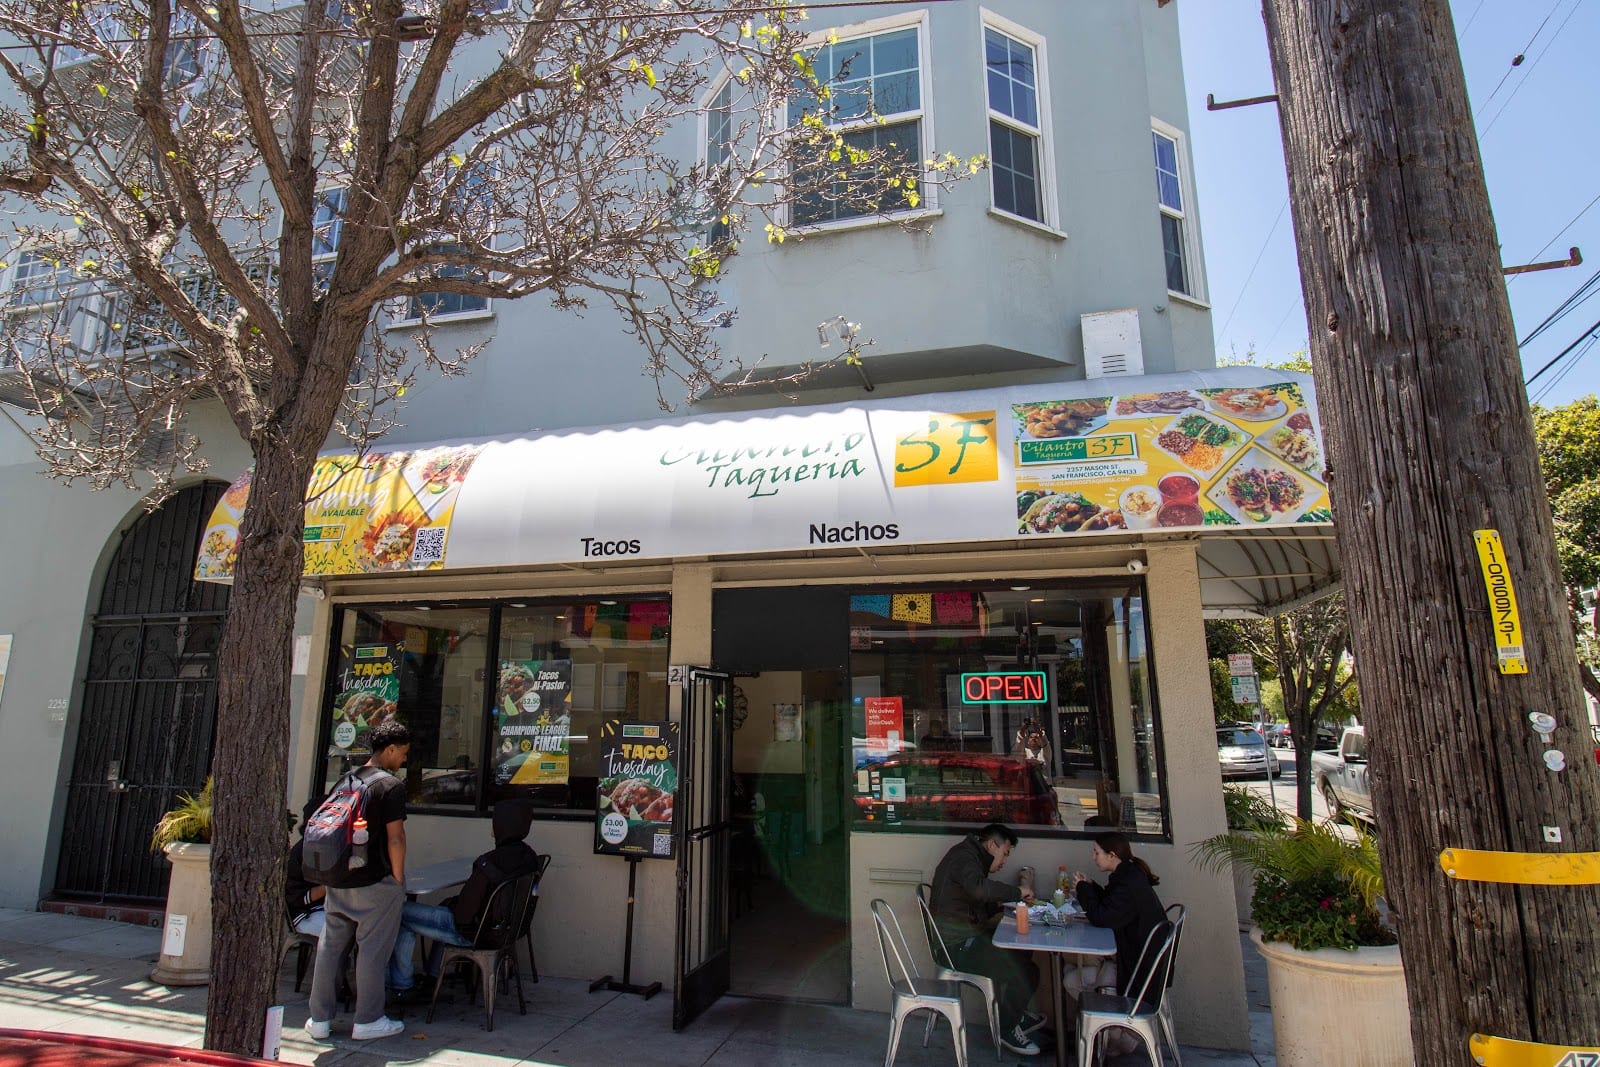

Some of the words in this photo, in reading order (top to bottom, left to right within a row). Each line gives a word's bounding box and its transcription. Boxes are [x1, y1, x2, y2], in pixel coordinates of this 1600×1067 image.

[895, 418, 995, 476] SF
[1022, 441, 1085, 452] Cilantro
[1091, 437, 1125, 455] SF
[1035, 452, 1073, 460] Taqueria
[705, 453, 866, 498] Taqueria
[321, 508, 365, 517] AVAILABLE
[808, 520, 899, 544] Nachos
[580, 535, 641, 556] Tacos
[354, 662, 393, 676] TACO
[538, 671, 559, 680] Tacos
[965, 675, 1043, 700] OPEN
[500, 725, 540, 736] CHAMPIONS
[541, 724, 567, 736] LEAGUE
[533, 735, 562, 752] FINAL
[622, 743, 668, 760] TACO
[605, 819, 623, 827] $3.00
